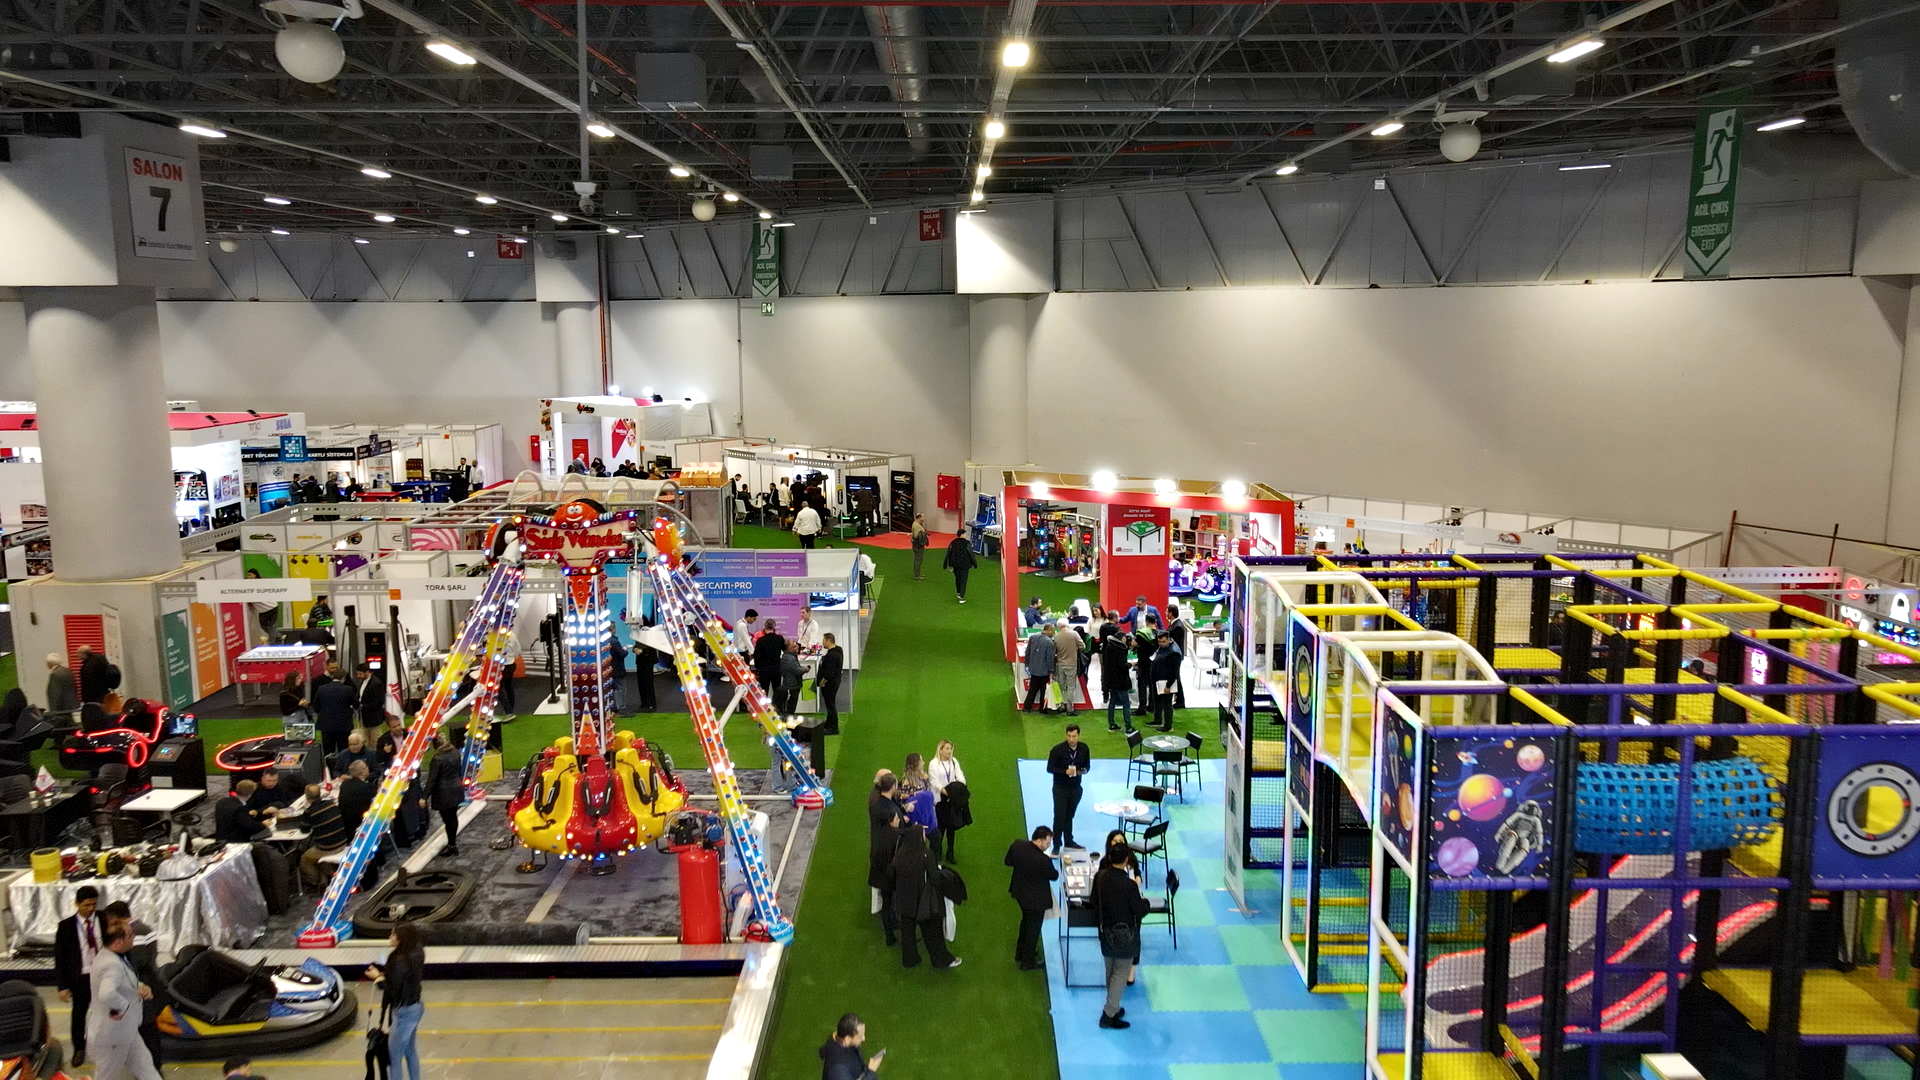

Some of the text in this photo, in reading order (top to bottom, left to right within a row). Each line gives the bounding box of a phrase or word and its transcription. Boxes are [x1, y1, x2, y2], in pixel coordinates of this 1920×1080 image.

[133, 157, 183, 181] SALON
[149, 185, 171, 232] 7
[1691, 222, 1729, 237] EMERGENCY
[1701, 239, 1715, 250] EXIT
[526, 528, 623, 550] Side Wonder
